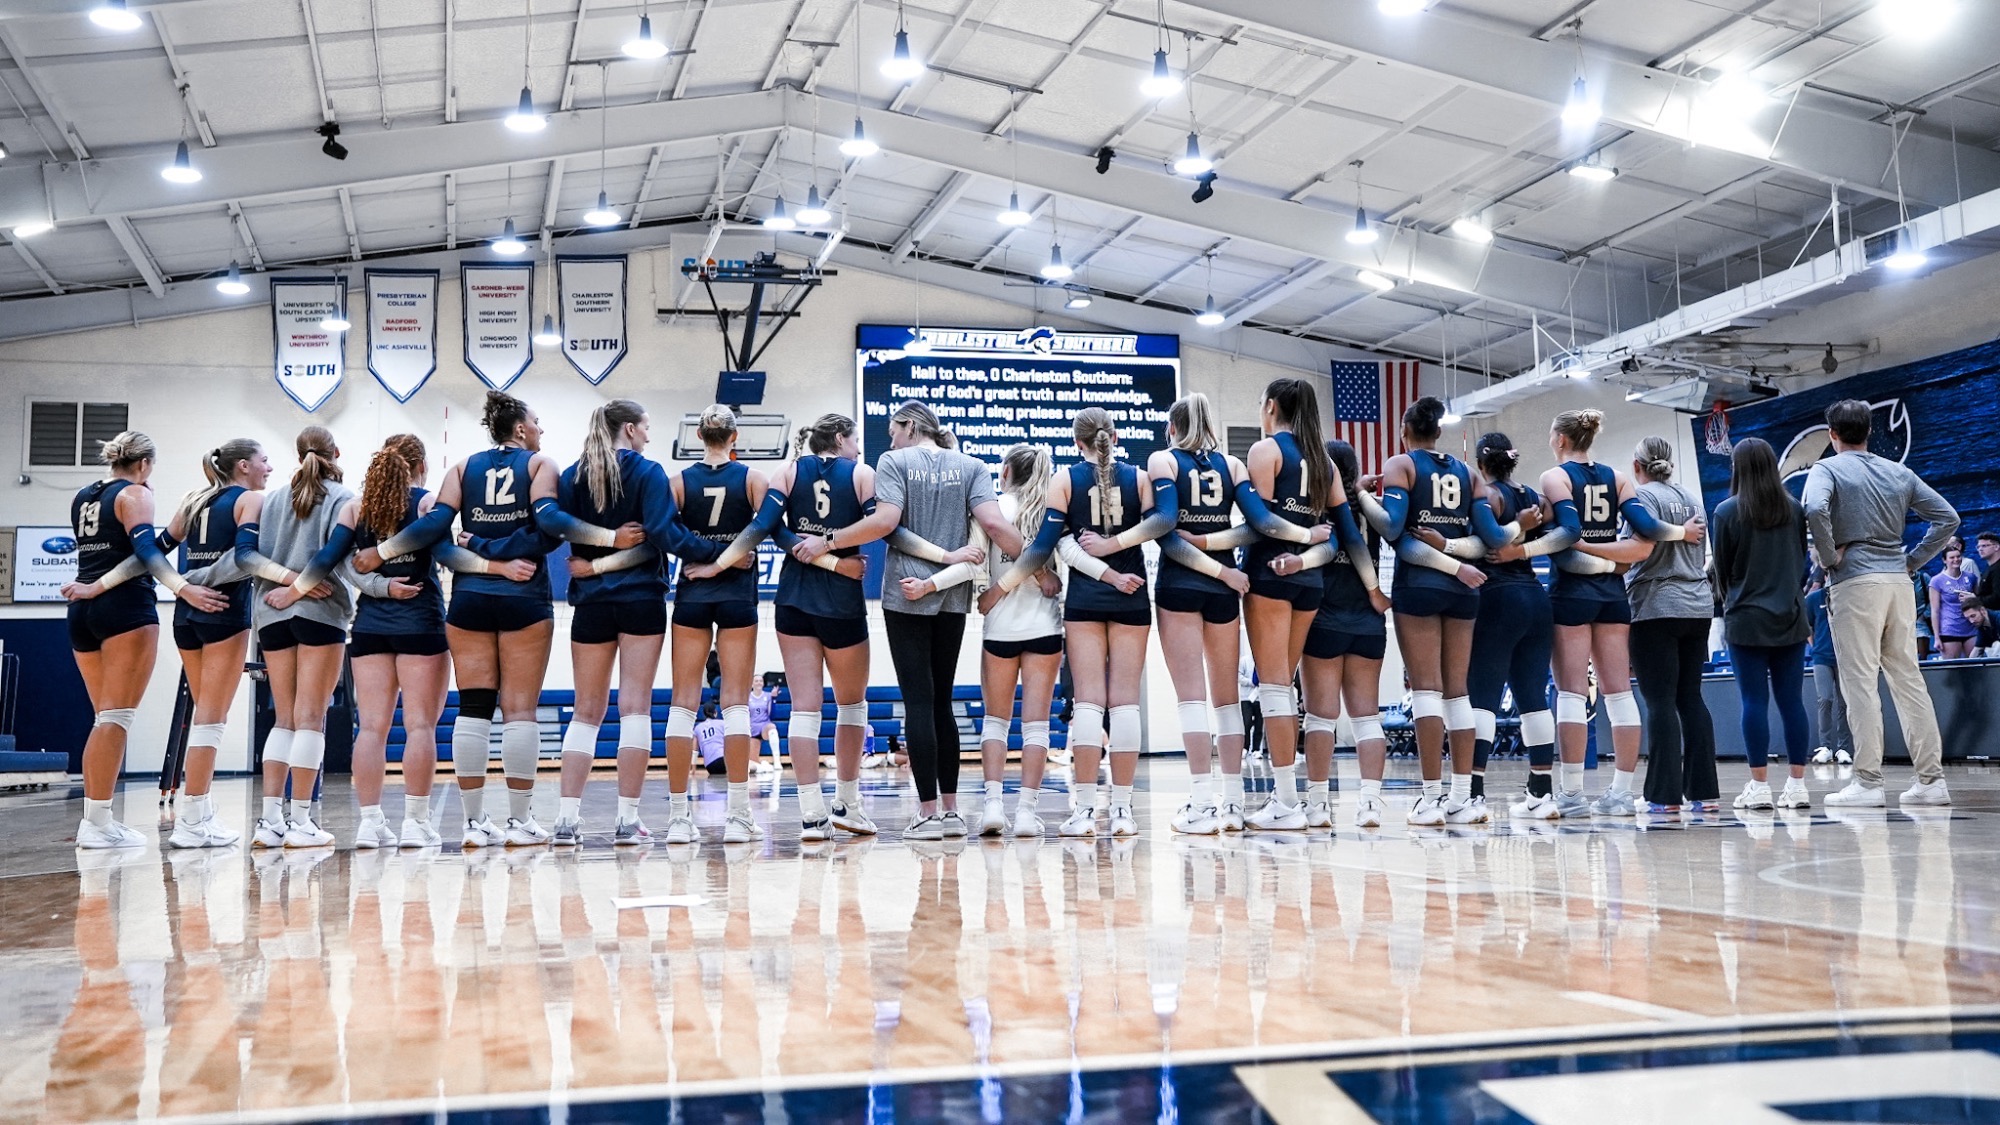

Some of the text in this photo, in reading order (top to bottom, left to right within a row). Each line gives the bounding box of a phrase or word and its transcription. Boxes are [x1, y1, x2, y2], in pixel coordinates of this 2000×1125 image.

[1051, 336, 1135, 353] SOUTHERN
[938, 367, 953, 380] to
[955, 367, 989, 383] thee,
[990, 368, 1000, 382] O
[1002, 368, 1070, 383] Charleston
[1072, 370, 1133, 385] Southern:
[891, 384, 1153, 405] Fount of God's great truth and knowledge.
[866, 402, 887, 416] We
[967, 404, 984, 417] all
[986, 405, 1015, 420] sing
[1016, 406, 1064, 420] praises
[1129, 409, 1143, 421] to
[955, 423, 1028, 439] inspiration,
[1055, 445, 1079, 457] and
[908, 469, 927, 481] DAY
[941, 469, 961, 481] DAY
[485, 466, 516, 506] 12
[1188, 469, 1223, 507] 13
[1431, 472, 1461, 509] 18
[703, 486, 726, 527] 7
[812, 478, 831, 519] 6
[1583, 484, 1610, 523] 15
[78, 501, 101, 537] 19
[32, 557, 78, 566] SUBAR
[702, 726, 715, 740] 10
